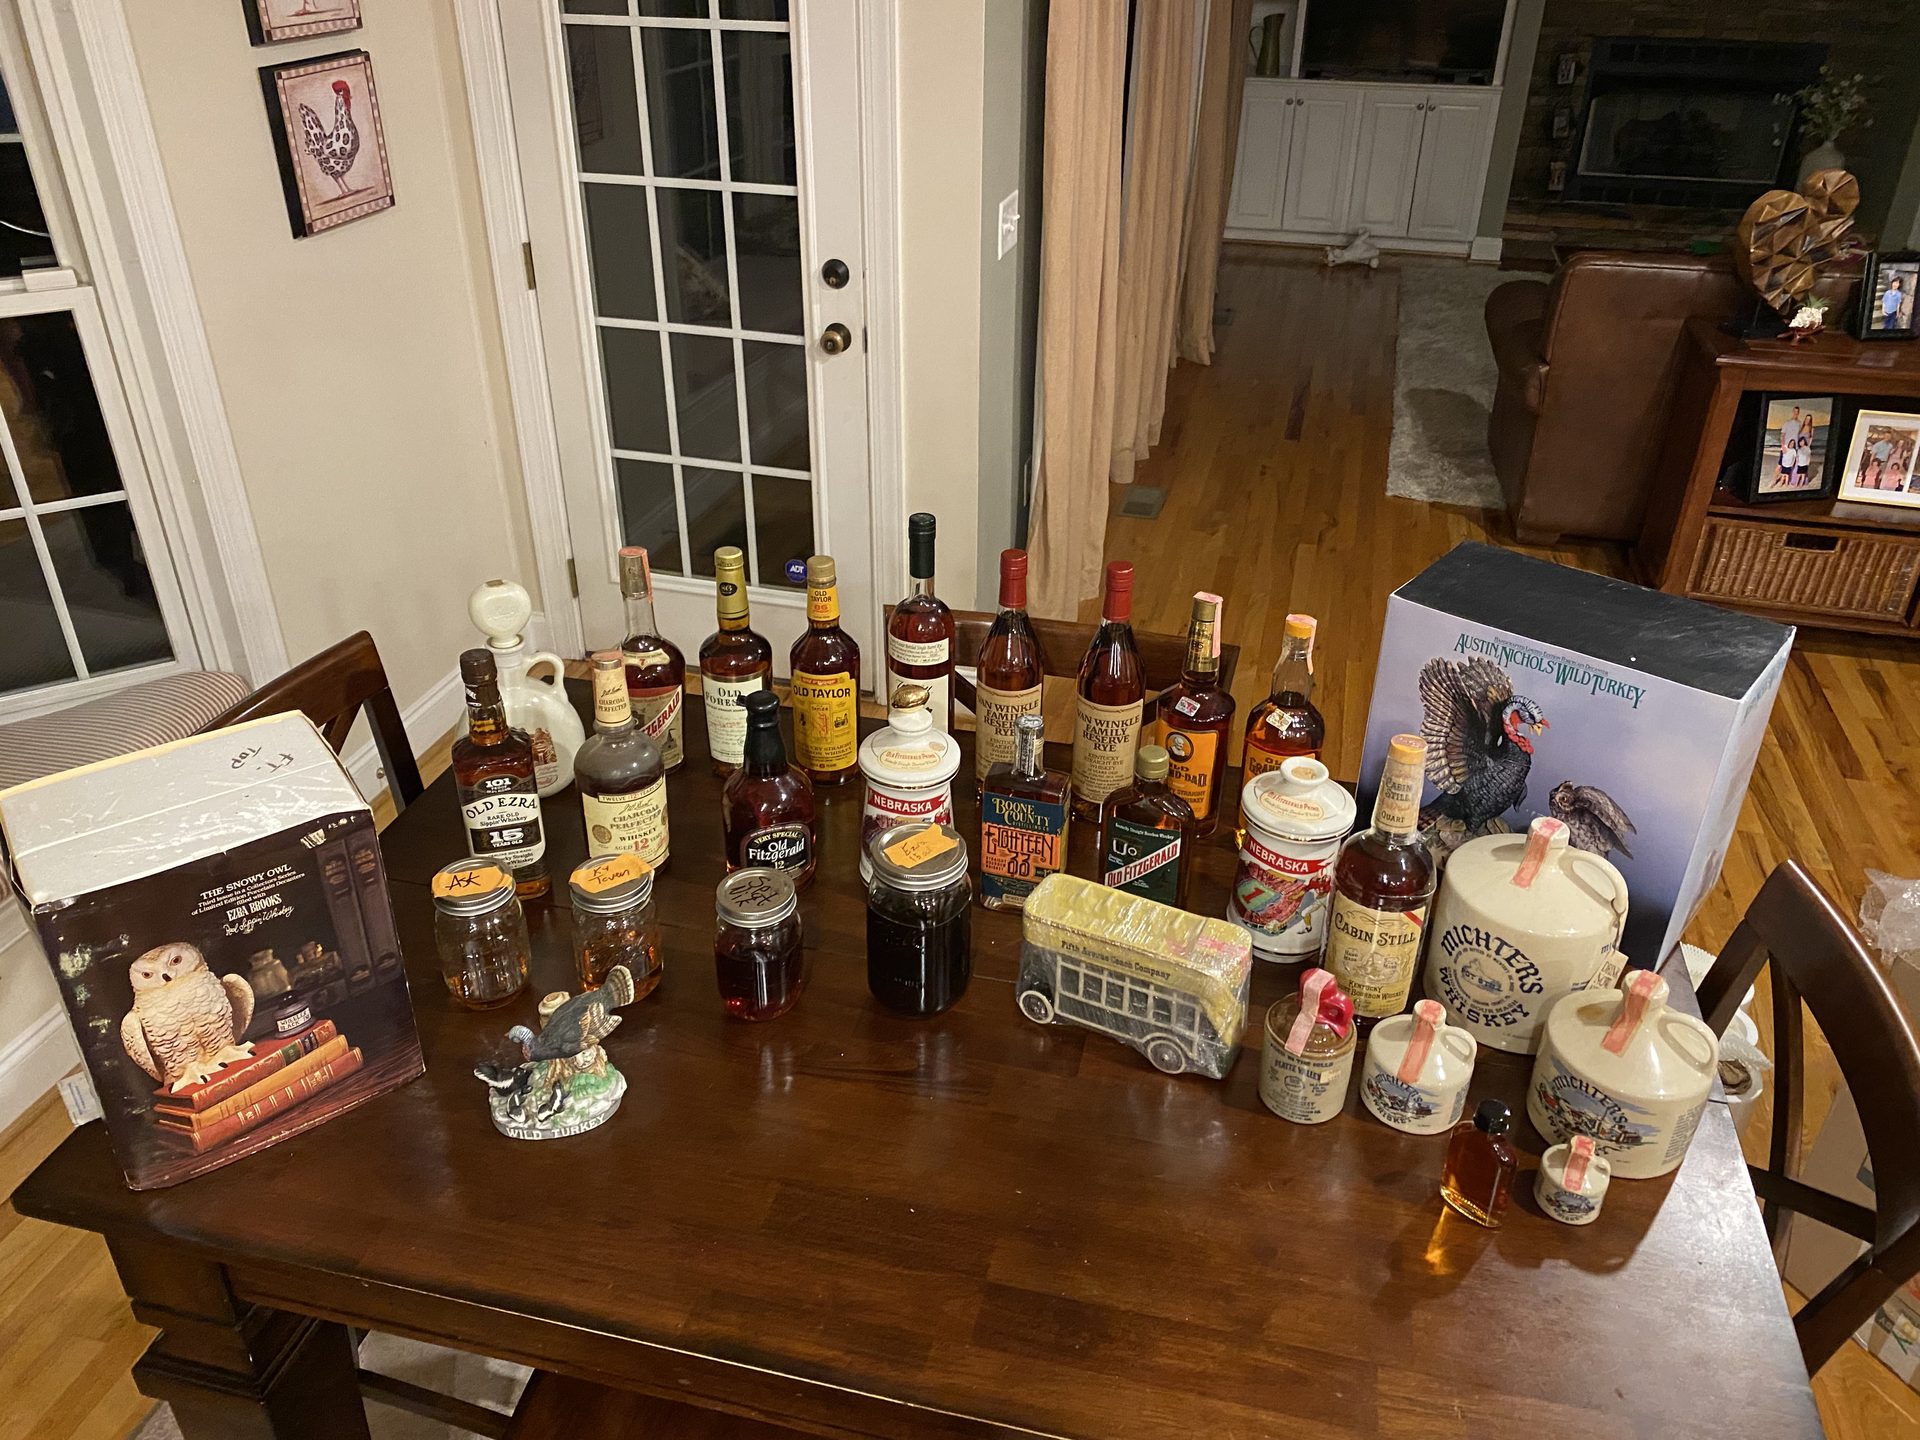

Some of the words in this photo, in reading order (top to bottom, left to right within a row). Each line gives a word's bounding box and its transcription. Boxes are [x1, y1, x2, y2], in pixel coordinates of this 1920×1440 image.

[790, 565, 805, 574] ADT
[639, 658, 646, 666] 7
[718, 687, 742, 698] OLD
[793, 685, 809, 697] OLD
[811, 688, 851, 698] TAYLOR
[1553, 661, 1591, 686] WILD
[1590, 674, 1646, 709] TURKEY
[705, 691, 737, 706] FORES
[977, 695, 992, 709] VAN
[994, 699, 1040, 713] WINKLE
[642, 691, 680, 737] ZGERALD
[984, 716, 1015, 729] RESER
[1077, 709, 1092, 724] VAN
[1093, 714, 1140, 728] WINKLE
[1083, 730, 1130, 744] RESERVE
[1086, 724, 1128, 736] FAMILY
[1094, 743, 1116, 752] RYE
[485, 778, 512, 788] 101
[1386, 777, 1413, 792] CABIN
[874, 794, 932, 813] NEBRASKA
[1385, 789, 1411, 801] STILL
[466, 801, 494, 819] OLD
[498, 797, 538, 809] EZRA
[613, 804, 660, 823] CHARCOAL
[992, 797, 1035, 816] BOONE
[610, 809, 661, 829] PERFECTED
[1004, 809, 1051, 827] COUNTY
[1382, 811, 1405, 823] QUART
[489, 828, 524, 843] 15
[619, 827, 657, 842] WHISKEY
[753, 834, 771, 845] VERY
[772, 831, 798, 839] SPECIAL
[634, 838, 649, 852] 12
[748, 837, 805, 863] Fitzgerald
[768, 839, 788, 852] Old
[984, 824, 1055, 866] EIGHTEEN
[774, 860, 785, 870] 12
[1007, 848, 1031, 877] 33
[1107, 871, 1123, 887] OLD
[1124, 843, 1178, 881] FITZGERALD
[1249, 840, 1309, 872] NEBRASKA
[198, 898, 216, 907] Third
[246, 877, 277, 891] Collectors
[278, 871, 297, 880] Series
[200, 886, 225, 900] THE
[226, 872, 265, 892] SNOWY
[267, 863, 292, 878] OWL
[199, 902, 225, 913] Limited
[224, 894, 247, 904] Edition
[247, 883, 276, 896] Porcelain
[276, 873, 306, 886] Decanters
[253, 892, 267, 900] with
[226, 906, 250, 921] EZRA
[249, 894, 282, 914] BROOKS
[1334, 912, 1374, 943] CABIN
[1377, 932, 1417, 946] STILL
[1061, 940, 1080, 954] Fifth
[1134, 963, 1171, 981] Company
[1441, 924, 1544, 995] MICHTER'S
[1349, 980, 1383, 993] KENTUCKY
[1351, 987, 1381, 999] BOURBON
[1381, 991, 1405, 1000] WHISKEY
[1440, 966, 1530, 1027] WHISKEY
[1274, 1060, 1297, 1073] PLATTE
[1553, 1075, 1628, 1124] MICHTER'S
[506, 1128, 542, 1140] WILD
[551, 1113, 605, 1139] TURKEY
